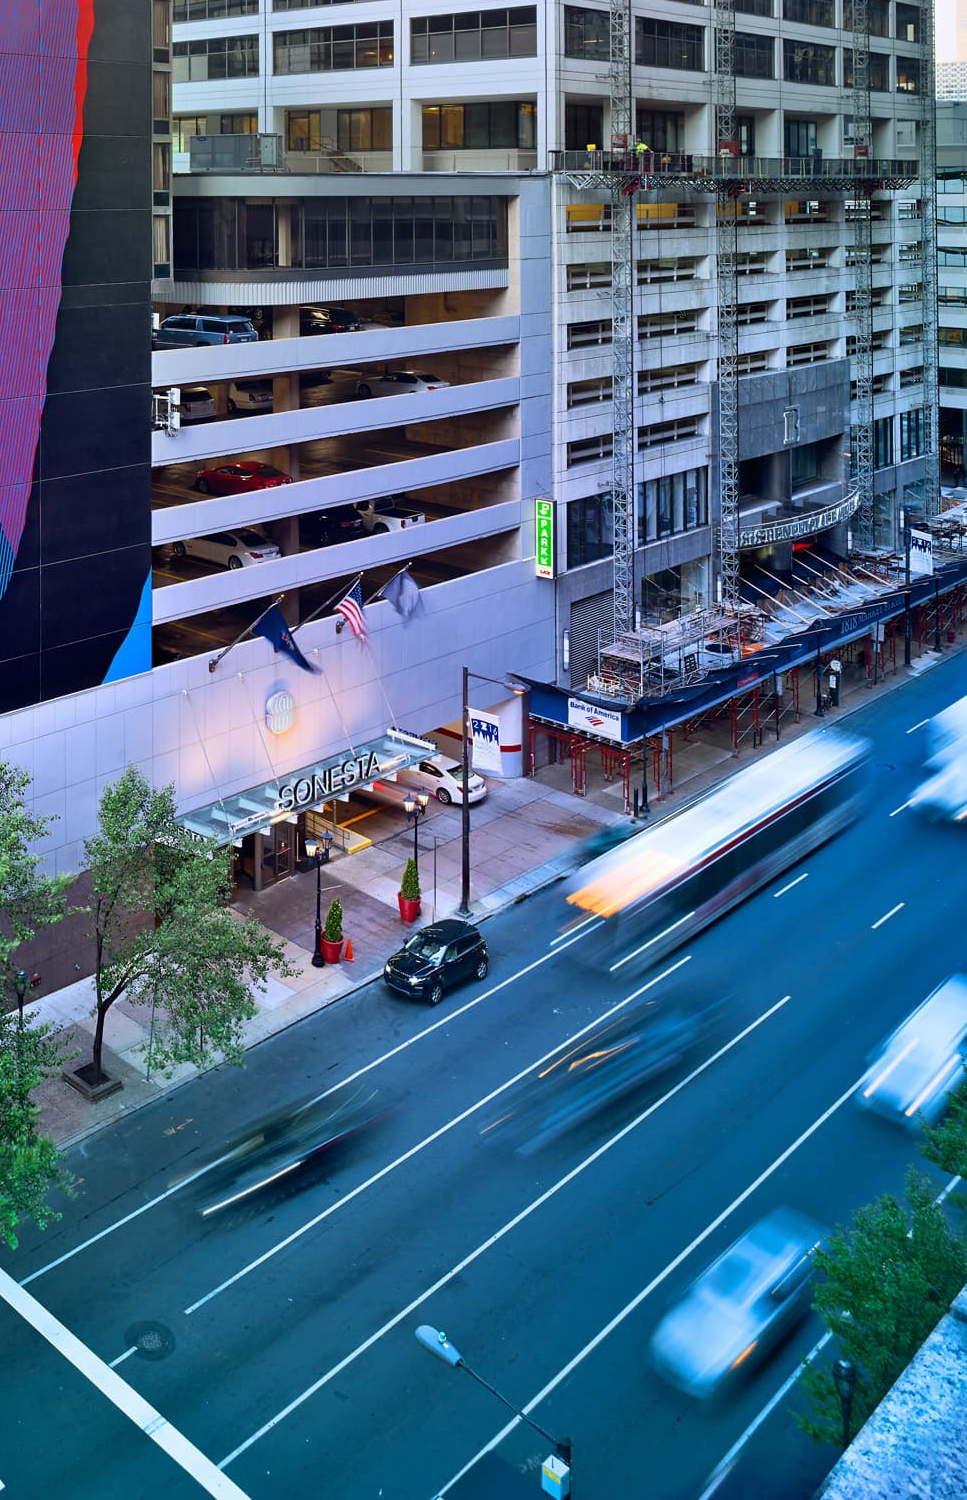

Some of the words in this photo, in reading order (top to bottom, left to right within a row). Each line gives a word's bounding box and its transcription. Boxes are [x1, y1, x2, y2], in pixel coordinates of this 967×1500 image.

[540, 519, 549, 557] PARK
[841, 616, 858, 634] 1818
[569, 701, 586, 711] Bank
[586, 706, 594, 714] of
[593, 707, 620, 722] America
[278, 751, 383, 812] SONESTA
